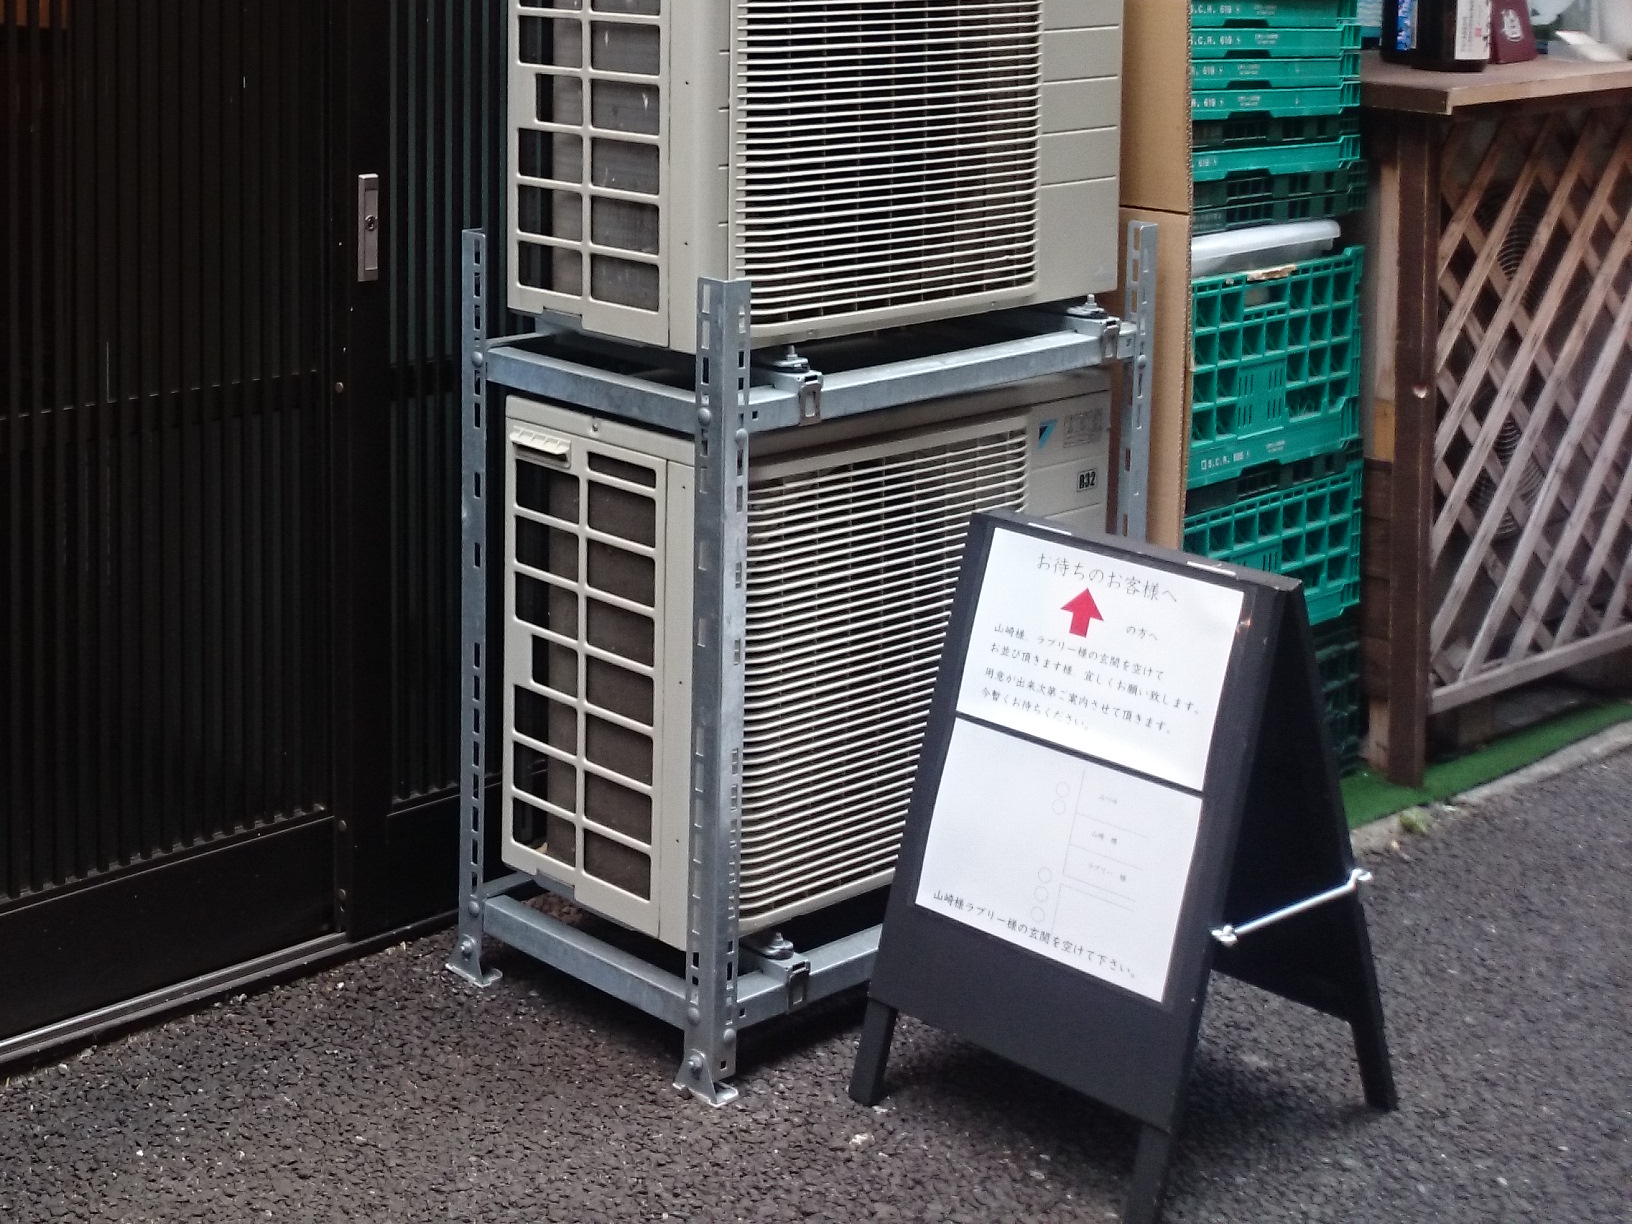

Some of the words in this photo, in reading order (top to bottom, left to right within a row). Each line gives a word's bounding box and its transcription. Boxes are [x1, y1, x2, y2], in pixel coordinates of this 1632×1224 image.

[1079, 471, 1096, 489] R32
[1037, 552, 1178, 603] お待ちのお客様へ
[1126, 625, 1159, 641] の方へ
[981, 687, 1089, 730] 今暫くお待ちください。
[985, 667, 1171, 734] 用意が出来次第ご案内させて頂きます。
[933, 890, 1136, 979] 山崎様ラブリー様の玄関を空けて下さい。
